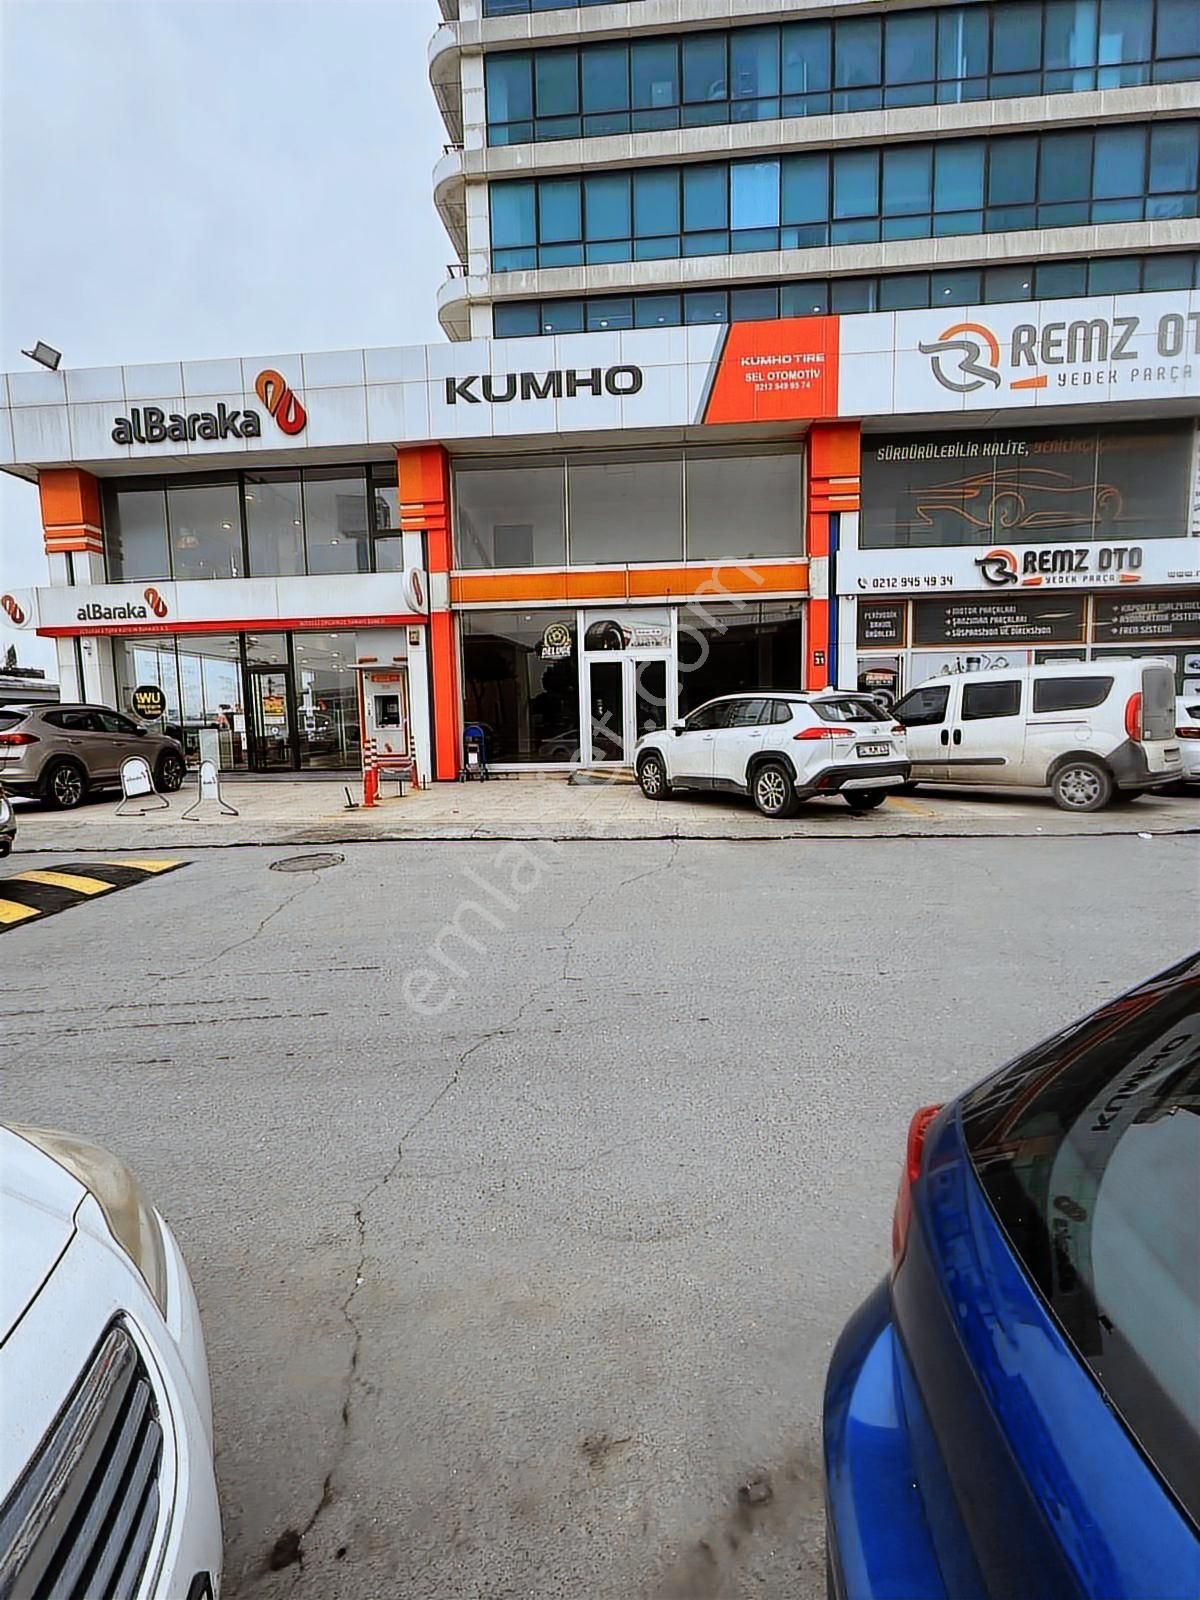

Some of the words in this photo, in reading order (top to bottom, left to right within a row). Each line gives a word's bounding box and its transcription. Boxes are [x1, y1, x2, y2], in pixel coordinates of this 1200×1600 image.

[1010, 316, 1140, 367] REMZ
[741, 354, 792, 367] KUMHO
[793, 352, 825, 364] TIRE
[445, 364, 643, 405] KUMHO
[1057, 370, 1118, 388] YEDEK
[1130, 364, 1192, 384] PARÇA
[111, 402, 261, 445] alBaraka
[877, 442, 980, 461] SÜRDÜRÜLEBİLİR
[982, 439, 1029, 458] KALİTE,
[1023, 548, 1090, 574] REMZ
[1099, 546, 1142, 571] OTO
[872, 578, 898, 588] 0212
[901, 576, 920, 587] 945
[924, 576, 937, 586] 49
[940, 575, 953, 586] 34
[1045, 574, 1077, 585] YEDEK
[1082, 573, 1115, 584] PARÇA
[77, 602, 148, 621] alBaraka
